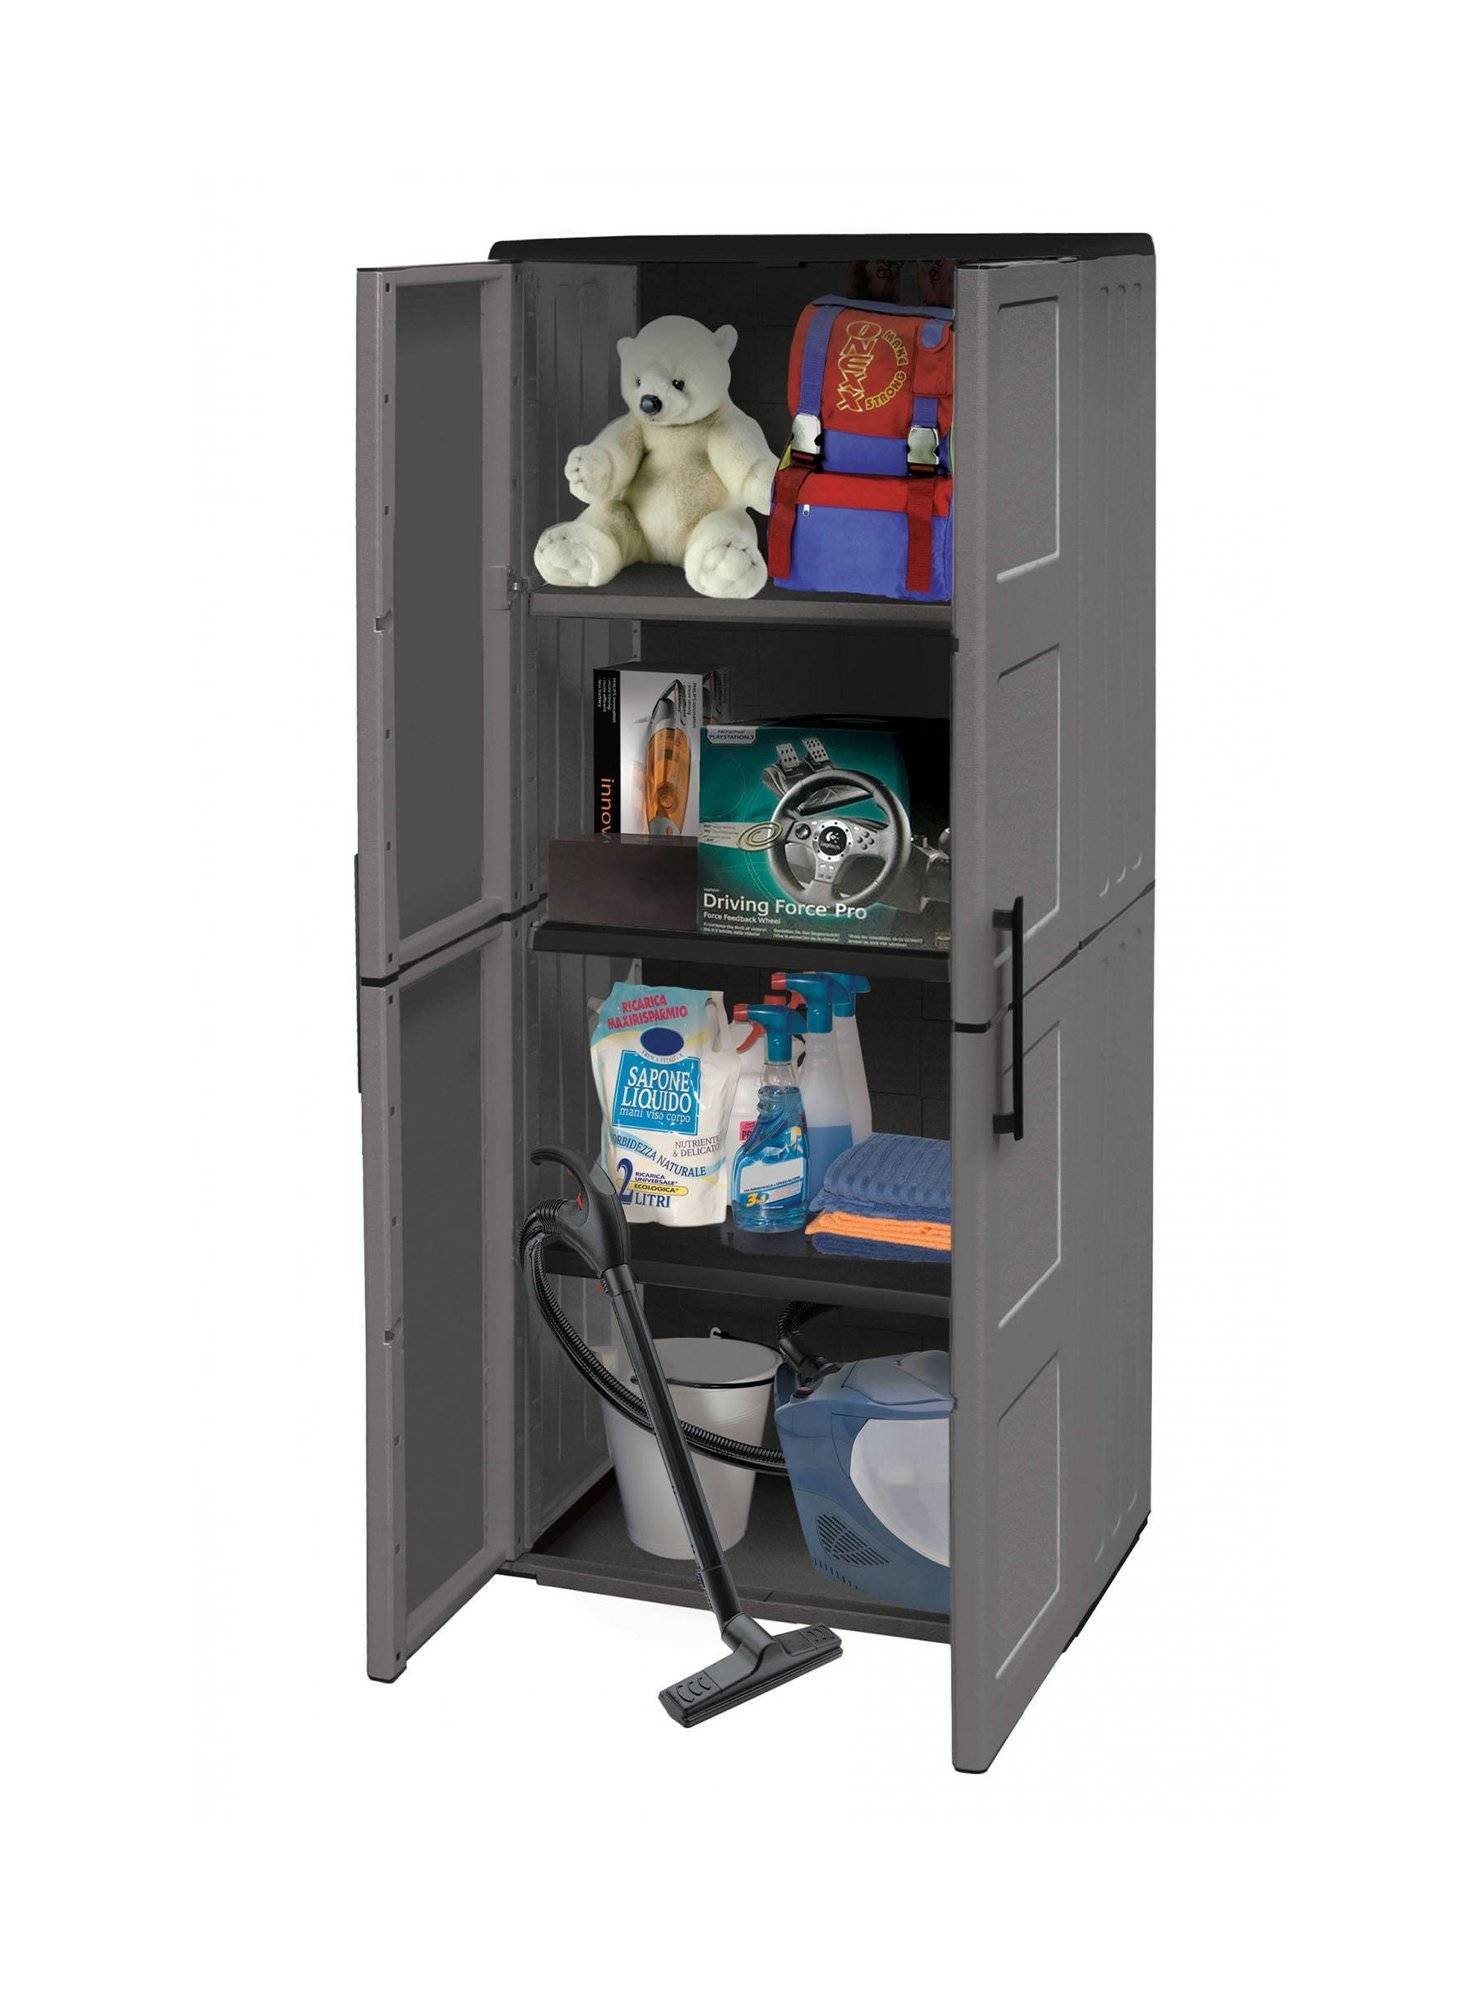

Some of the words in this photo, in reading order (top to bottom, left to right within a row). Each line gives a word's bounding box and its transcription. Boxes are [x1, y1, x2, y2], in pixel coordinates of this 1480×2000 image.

[882, 329, 909, 366] MAKE
[865, 370, 907, 410] STRONG
[704, 893, 769, 916] Driving
[775, 899, 827, 917] Force
[836, 903, 868, 920] Pro
[704, 911, 722, 920] Force
[723, 913, 756, 923] Feedback
[758, 916, 781, 925] Wheel
[622, 994, 668, 1013] RICARICA
[627, 1066, 691, 1092] SAPONE
[620, 1086, 692, 1113] LIQUIDO
[620, 1107, 643, 1118] mani
[646, 1110, 664, 1120] viso
[666, 1113, 691, 1124] corpo
[612, 1134, 657, 1161] ORBIDEZZA
[657, 1155, 707, 1177] NATURALE
[616, 1157, 634, 1205] 2
[635, 1193, 671, 1208] LITRI
